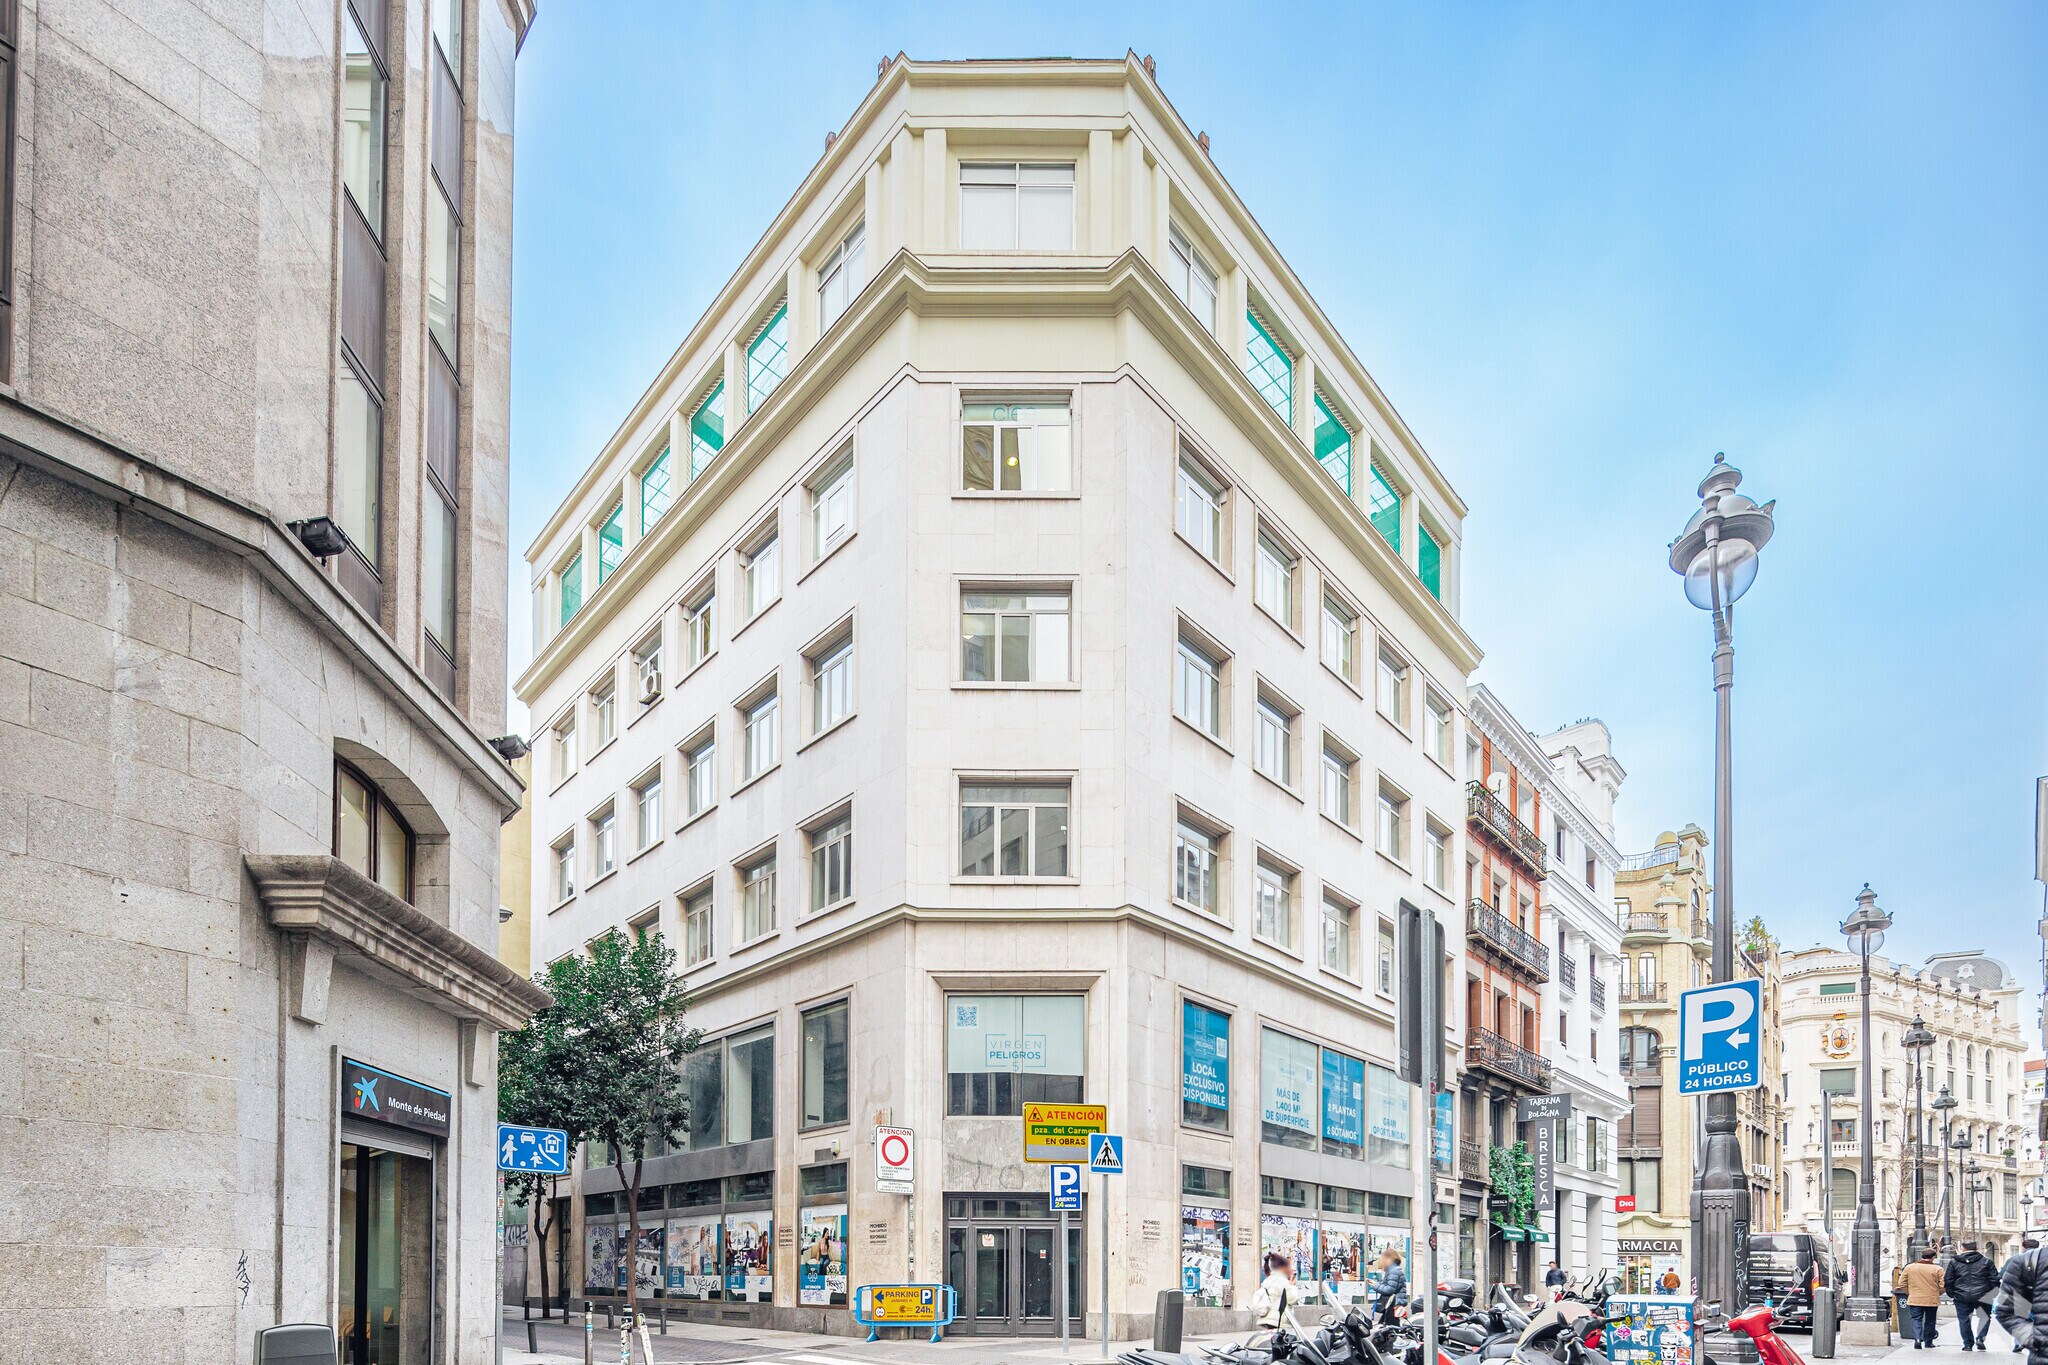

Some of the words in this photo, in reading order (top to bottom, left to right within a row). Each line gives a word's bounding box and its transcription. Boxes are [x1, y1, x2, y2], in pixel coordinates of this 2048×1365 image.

[1684, 988, 1754, 1061] P
[989, 1040, 1042, 1050] VIRGEN
[989, 1050, 1041, 1060] PELIGROS
[1012, 1061, 1020, 1072] 5
[1192, 1062, 1217, 1078] LOCAL
[1689, 1060, 1748, 1075] PÚBLICO
[1184, 1074, 1225, 1093] EXCLUSIVO
[1685, 1080, 1699, 1089] 24
[1703, 1073, 1752, 1087] HORAS
[1183, 1087, 1226, 1107] DISPONIBLE
[1276, 1088, 1290, 1099] MÁS
[1292, 1091, 1300, 1101] DE
[1528, 1096, 1561, 1106] TABERNA
[388, 1097, 412, 1112] Monte
[413, 1105, 422, 1116] de
[423, 1107, 446, 1122] Piedad
[1046, 1110, 1104, 1121] ATENCIÓN
[1328, 1103, 1332, 1112] 2
[1332, 1105, 1356, 1118] PLANTAS
[1265, 1109, 1274, 1120] DE
[1275, 1112, 1310, 1128] SUPERFICIE
[1383, 1117, 1397, 1128] GRAN
[879, 1127, 912, 1136] ATENCIÓN
[1034, 1127, 1050, 1135] pza.
[1053, 1126, 1065, 1134] del
[1067, 1126, 1097, 1134] Carmen
[1327, 1126, 1331, 1135] 2
[1331, 1125, 1357, 1140] SÓTANOS
[1372, 1125, 1406, 1140] OPORTUNIDAD
[1059, 1138, 1086, 1146] OBRAS
[1539, 1128, 1549, 1205] BRESCA
[1053, 1166, 1077, 1197] P
[1617, 1240, 1679, 1251] ARMACIA
[921, 1290, 932, 1304] P
